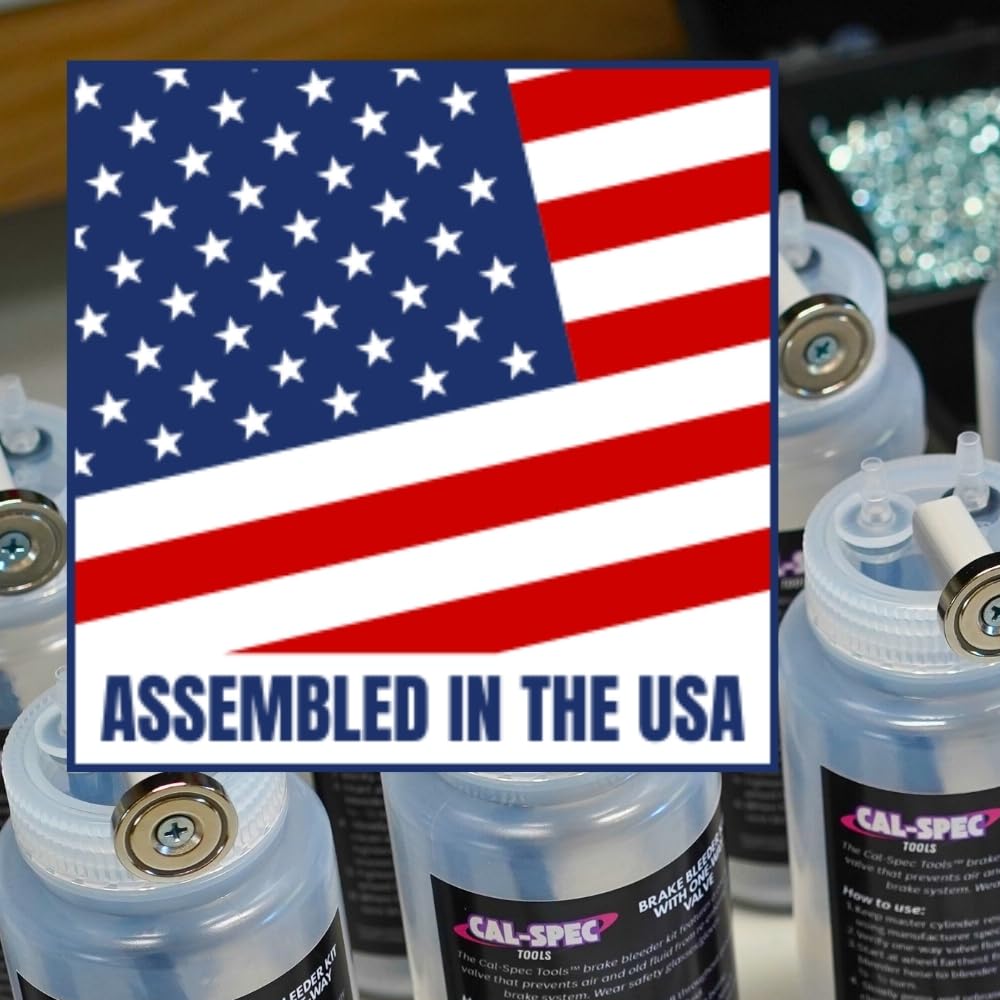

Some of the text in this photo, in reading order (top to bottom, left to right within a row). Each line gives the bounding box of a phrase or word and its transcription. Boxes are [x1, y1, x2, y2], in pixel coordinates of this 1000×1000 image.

[856, 806, 985, 840] CAL-SPEC
[903, 841, 937, 854] TOOLS
[638, 877, 684, 913] BRAKE
[653, 890, 687, 918] WITH
[683, 872, 714, 911] VALVE
[842, 885, 926, 916] How to use:
[469, 916, 599, 947] CAL-SPEC
[324, 943, 337, 970] KIT
[457, 951, 475, 963] The
[479, 959, 533, 976] Cal-Spec
[583, 958, 618, 973] brake
[518, 950, 552, 961] TOOLS
[461, 966, 490, 981] valve
[493, 974, 518, 987] that
[522, 980, 578, 990] prevents
[581, 977, 598, 987] air
[601, 969, 625, 982] and
[628, 961, 647, 975] old
[594, 984, 624, 998] Wear
